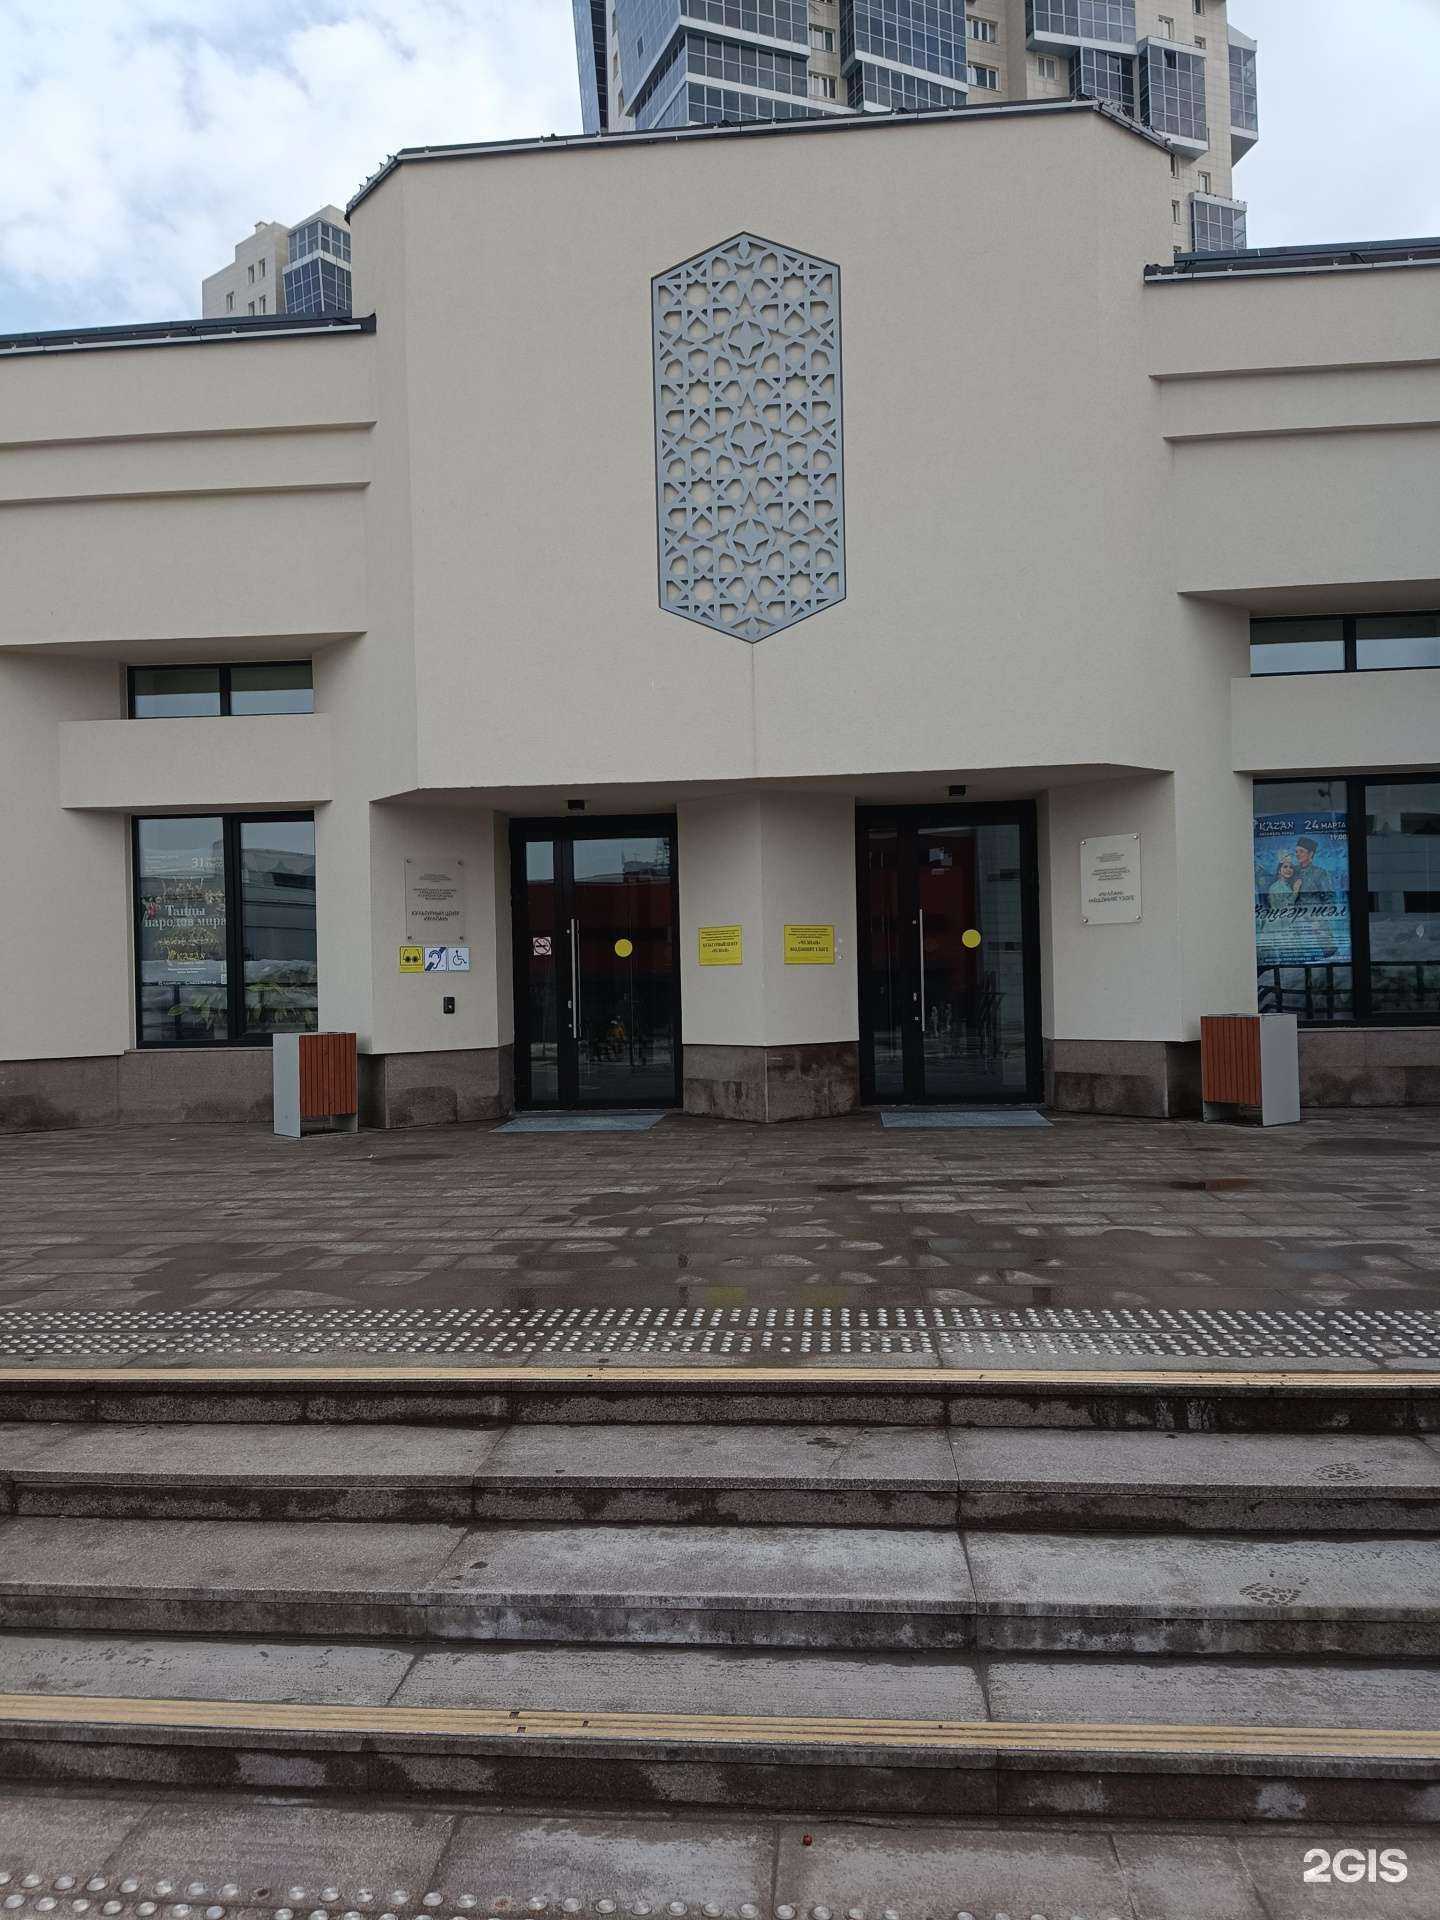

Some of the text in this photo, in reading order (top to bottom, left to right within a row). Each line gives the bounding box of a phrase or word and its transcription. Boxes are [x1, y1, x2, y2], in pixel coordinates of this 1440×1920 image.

[1304, 819, 1346, 830] 24 МАРТА
[165, 905, 207, 917] Танцы
[145, 918, 194, 930] народов
